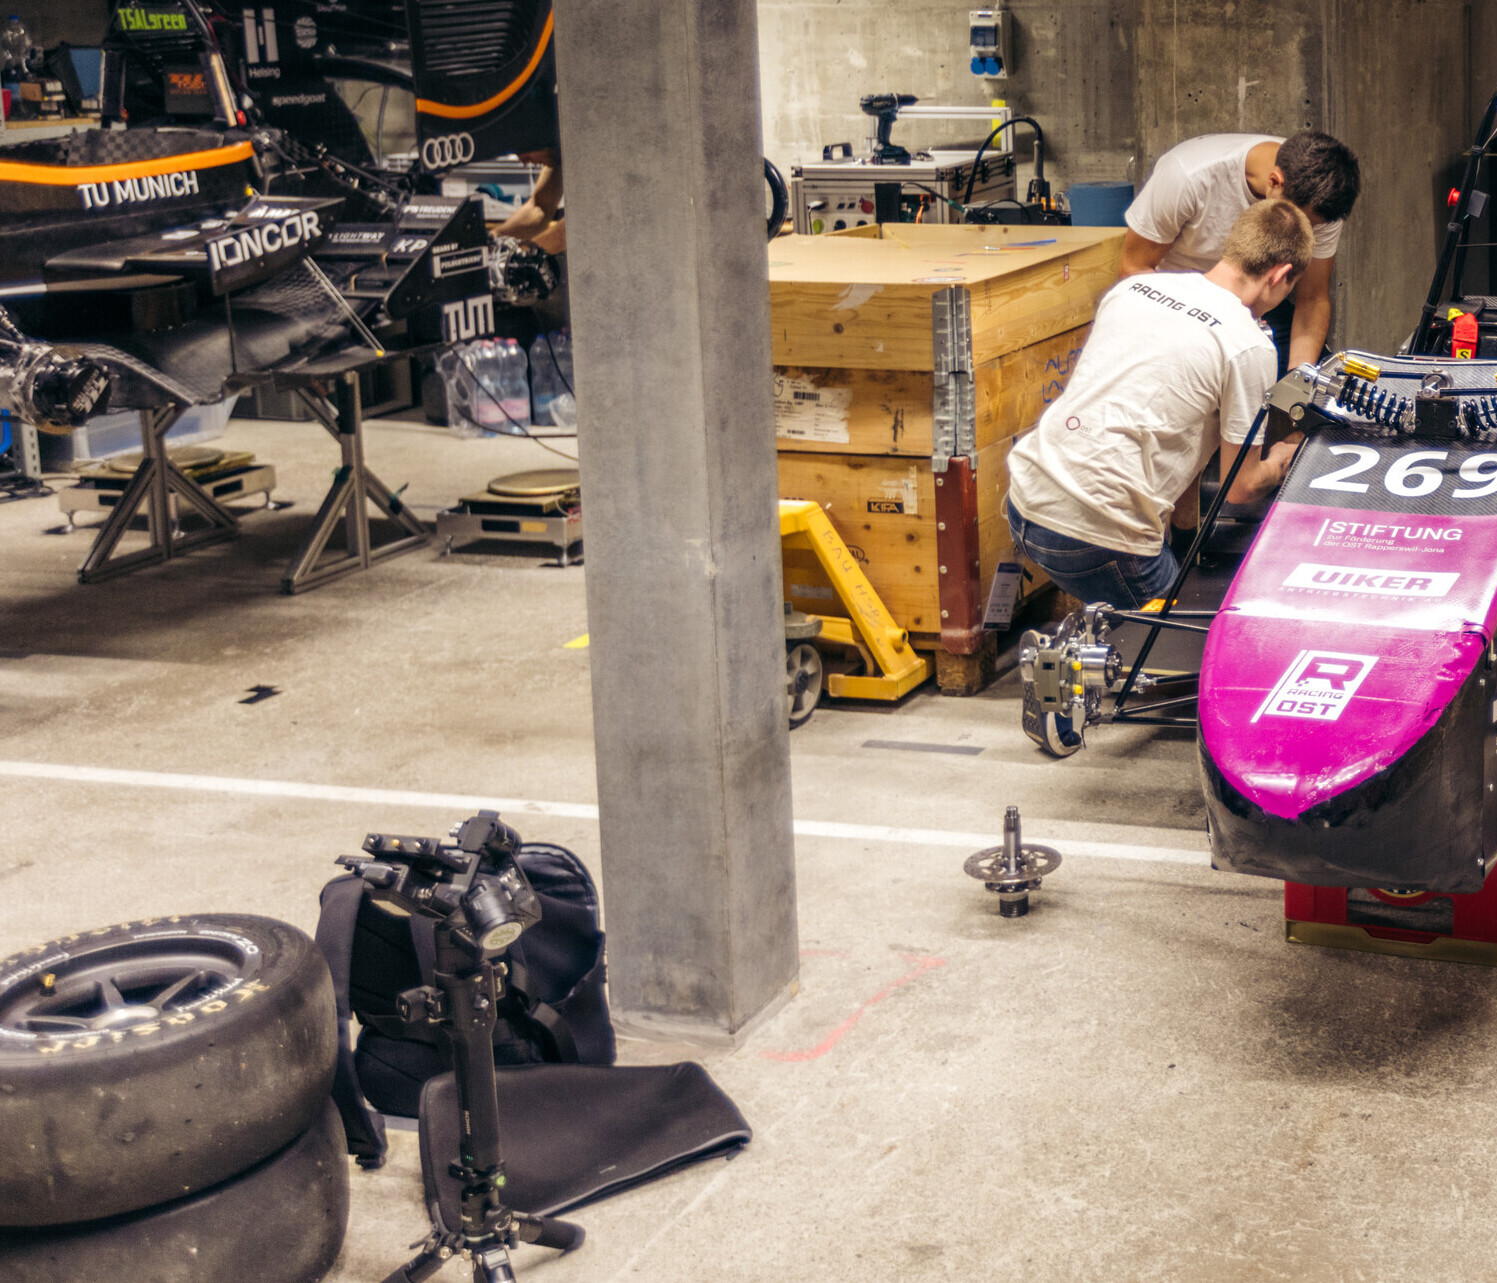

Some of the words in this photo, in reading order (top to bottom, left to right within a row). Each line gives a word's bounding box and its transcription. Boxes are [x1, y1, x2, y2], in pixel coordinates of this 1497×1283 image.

[118, 7, 187, 30] TSALgreen
[249, 67, 281, 79] Helsing
[78, 182, 110, 209] TU
[114, 170, 200, 205] MUNICH
[211, 211, 322, 271] IONCOR
[1128, 282, 1186, 311] RACING
[1186, 307, 1222, 327] OST
[1329, 521, 1463, 541] STIFTUNG
[1342, 541, 1362, 549] OST
[1364, 543, 1445, 554] Rapperswil-Jona
[1311, 570, 1433, 591] UIKER
[1286, 688, 1345, 700] RACING
[1276, 700, 1337, 716] OST
